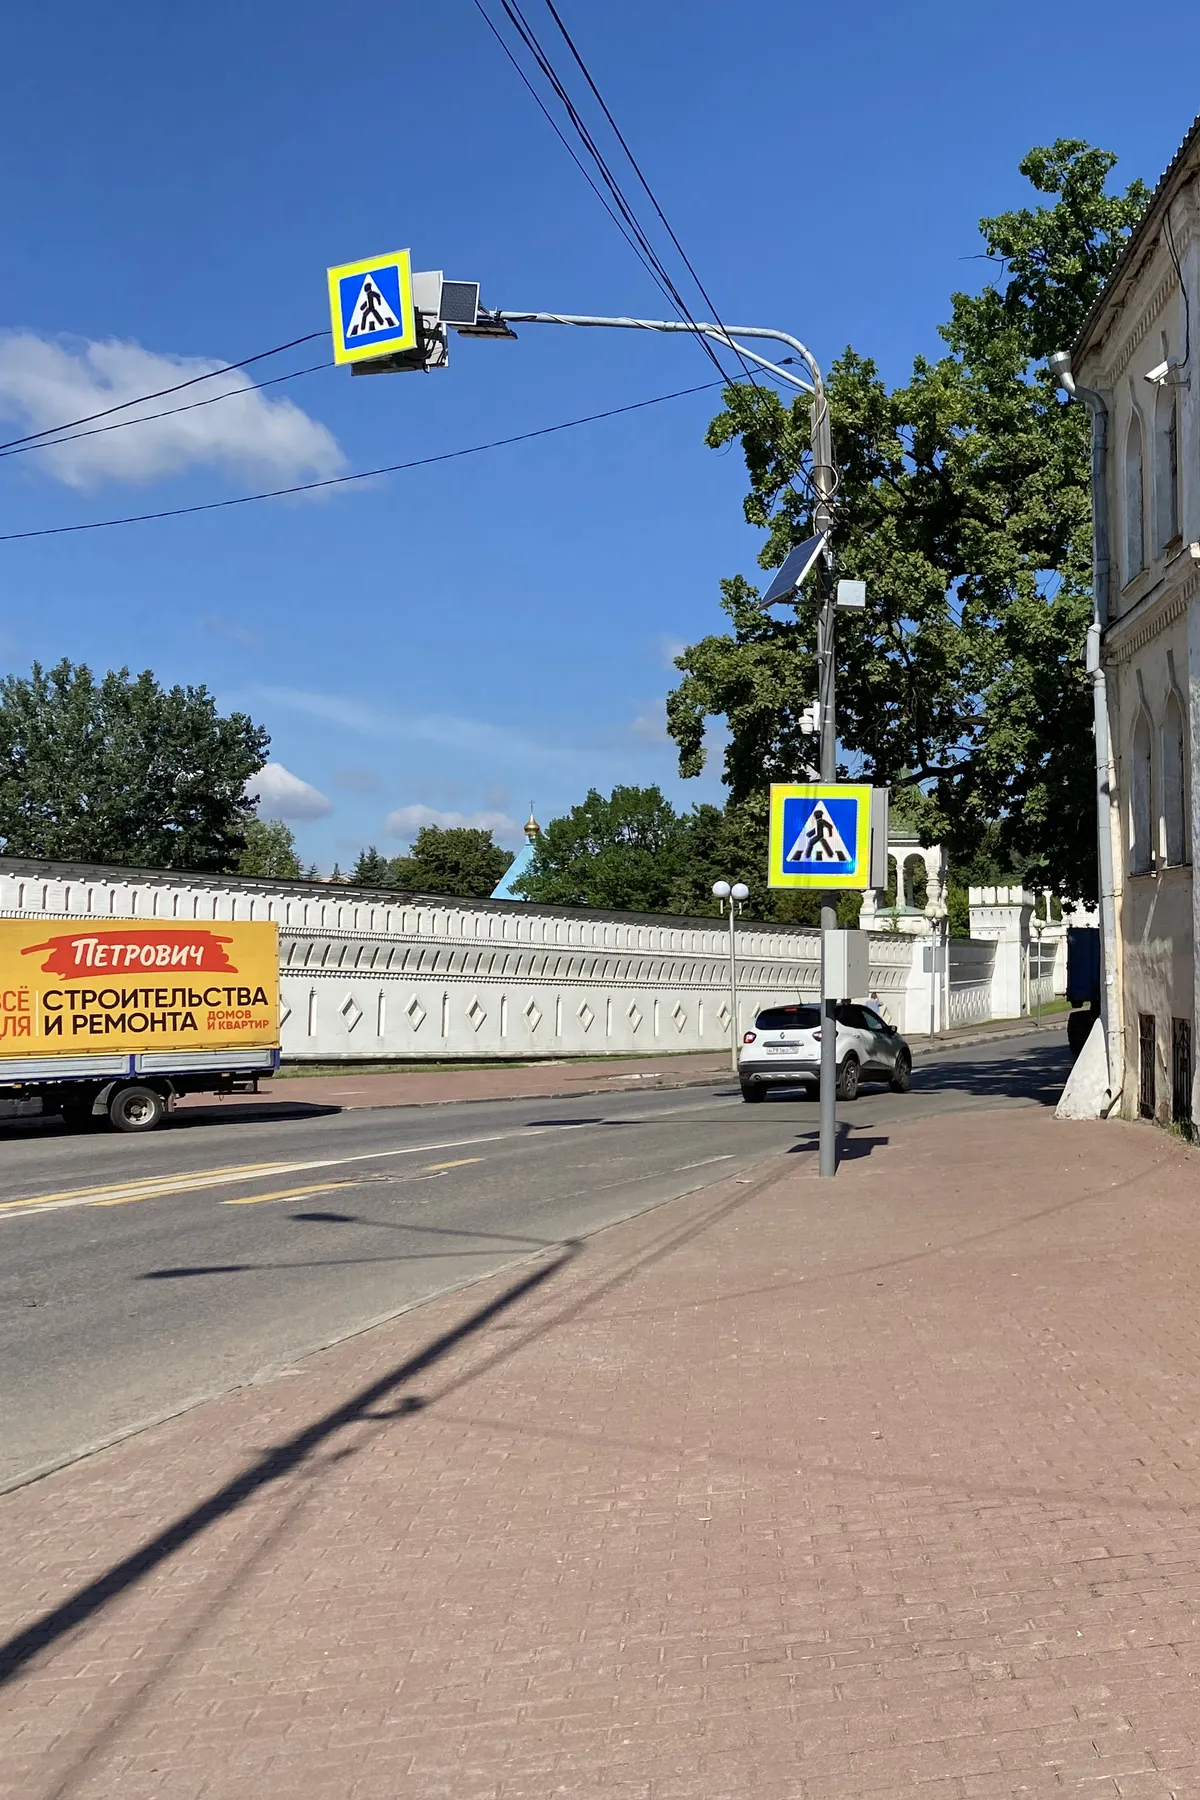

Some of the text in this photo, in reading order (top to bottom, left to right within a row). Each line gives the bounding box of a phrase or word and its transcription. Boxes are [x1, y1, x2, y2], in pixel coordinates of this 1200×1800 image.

[0, 985, 30, 1012] СЁ
[42, 986, 269, 1011] СТРОИТЕЛЬСТВА
[0, 1015, 31, 1040] ЛЯ
[44, 1011, 198, 1036] И РЕМОНТА
[207, 1010, 252, 1021] ДОМОВ
[207, 1020, 269, 1030] И КВАРТИР
